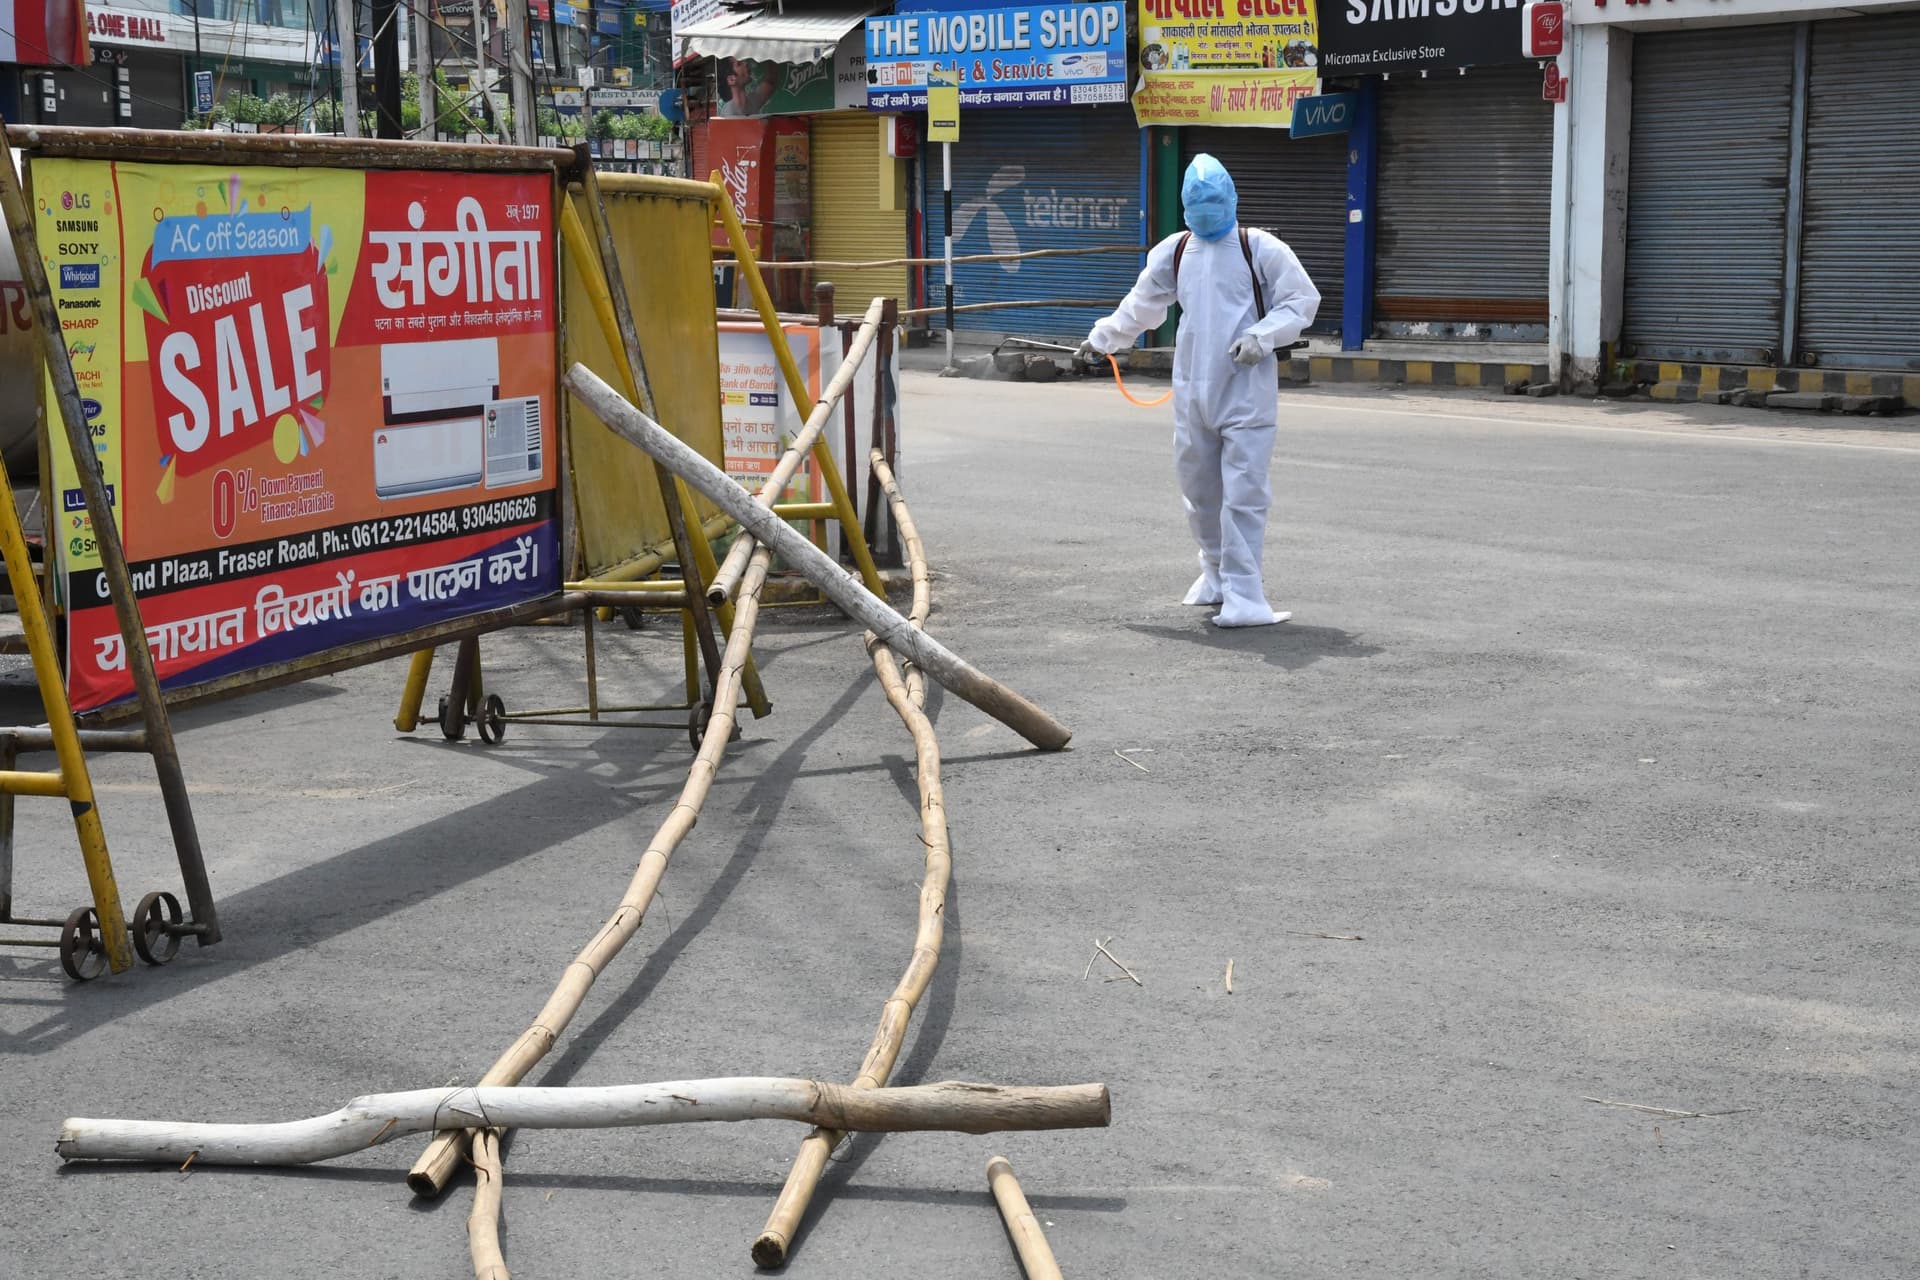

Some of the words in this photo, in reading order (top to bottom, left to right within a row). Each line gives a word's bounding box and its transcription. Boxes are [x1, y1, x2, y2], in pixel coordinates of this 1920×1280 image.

[441, 5, 474, 13] Lenov
[87, 12, 96, 35] A
[98, 13, 126, 38] ONE
[128, 17, 165, 42] MALL
[869, 19, 919, 56] THE
[928, 12, 1031, 53] MOBILE
[1040, 6, 1119, 48] SHOP
[1162, 23, 1194, 38] शाकाहारी
[1198, 22, 1208, 38] एवं
[1211, 22, 1243, 38] मांसाहारी
[1246, 22, 1270, 36] भोजन
[1273, 23, 1301, 35] उपलब्ध
[1325, 52, 1370, 65] Micromax
[1373, 49, 1416, 62] Exclusive
[1419, 46, 1445, 58] Store
[973, 60, 985, 81] &
[872, 93, 890, 107] यहाँ
[890, 92, 910, 106] सभी
[911, 95, 928, 107] प्रक
[994, 92, 1022, 102] बनाया
[1025, 91, 1051, 101] जाता
[1053, 86, 1066, 101] है।
[75, 194, 90, 208] LG
[1024, 189, 1128, 228] telenor
[57, 220, 98, 232] SAMSUNG
[171, 224, 200, 253] AC
[206, 221, 232, 250] off
[235, 221, 299, 248] Season
[58, 243, 99, 255] SONY
[369, 196, 541, 309] संगीता
[64, 271, 96, 284] Whirlpool
[59, 298, 101, 309] Panasonic
[185, 272, 252, 314] Discount
[62, 319, 98, 330] SHARP
[374, 317, 392, 331] पटना
[394, 317, 405, 329] का
[407, 312, 425, 329] सबसे
[428, 315, 446, 333] पुराना
[449, 311, 461, 327] और
[159, 284, 323, 453] SALE
[744, 422, 758, 434] का
[761, 423, 775, 434] घर
[731, 435, 744, 451] भी
[260, 477, 286, 498] Down
[287, 469, 323, 494] Payment
[212, 468, 258, 540] 0%
[261, 500, 296, 523] Finance
[298, 490, 335, 516] Available
[96, 568, 155, 598] Gnd
[162, 560, 213, 586] Plaza,
[219, 549, 274, 576] Fraser
[278, 538, 319, 564] Road,
[352, 509, 459, 549] 0612-2214584,
[463, 496, 537, 530] 9304506626
[94, 606, 247, 672] यतायात
[254, 570, 355, 638] नियमों
[358, 574, 400, 612] का
[407, 557, 483, 602] पालन
